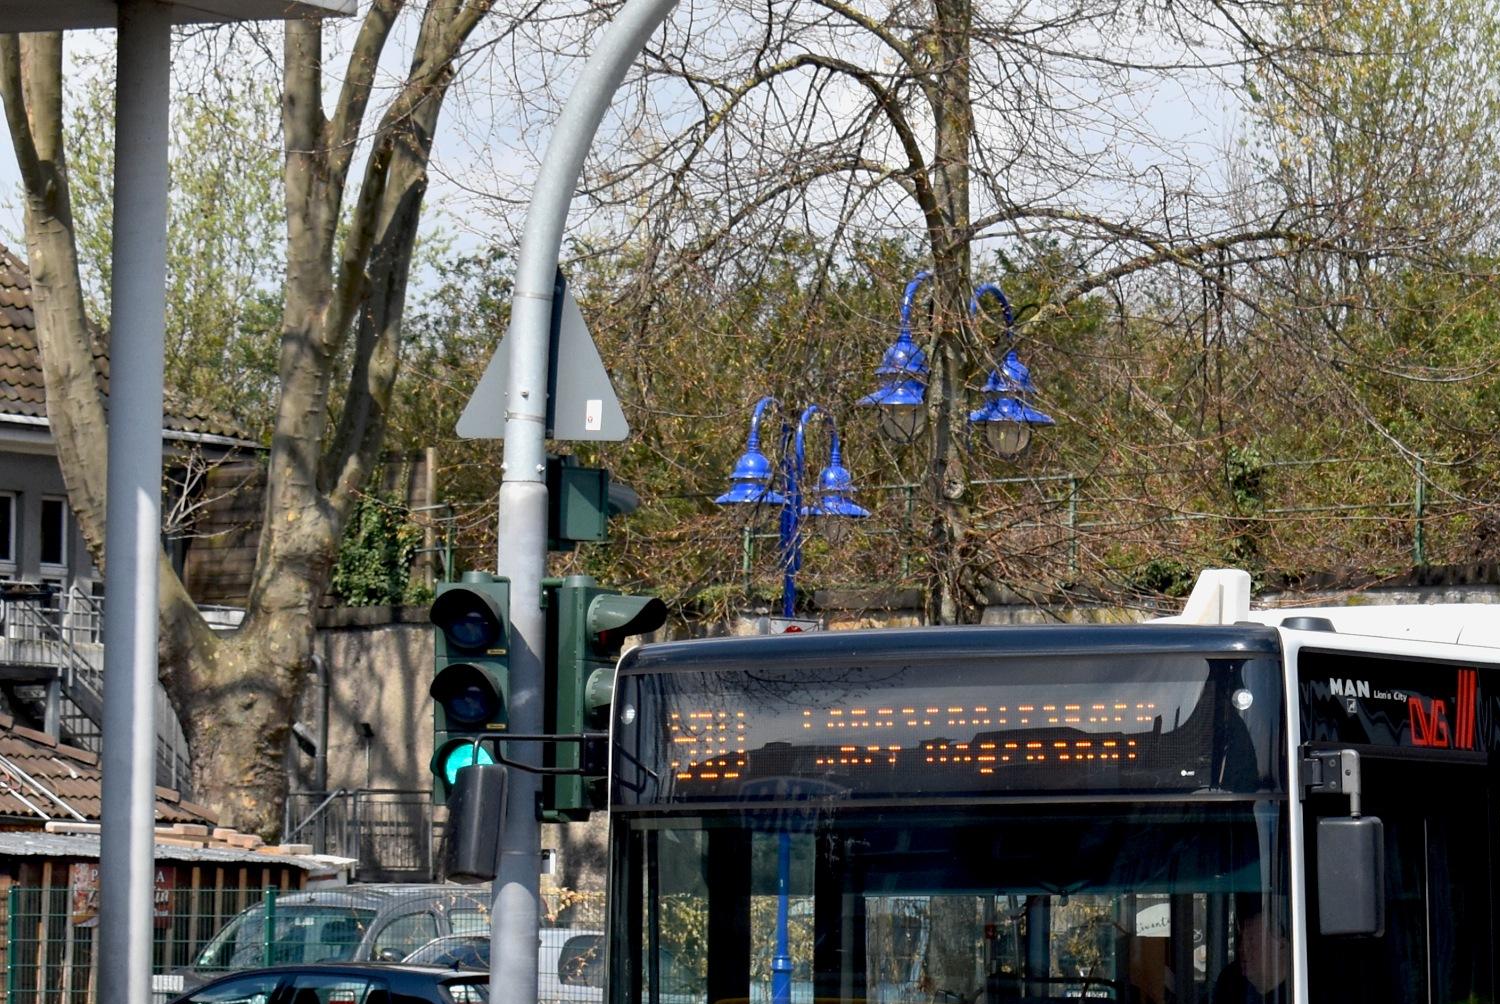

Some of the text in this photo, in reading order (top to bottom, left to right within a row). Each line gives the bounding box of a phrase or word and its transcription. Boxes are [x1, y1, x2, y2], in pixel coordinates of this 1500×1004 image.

[1329, 677, 1408, 702] MAN Lion's City
